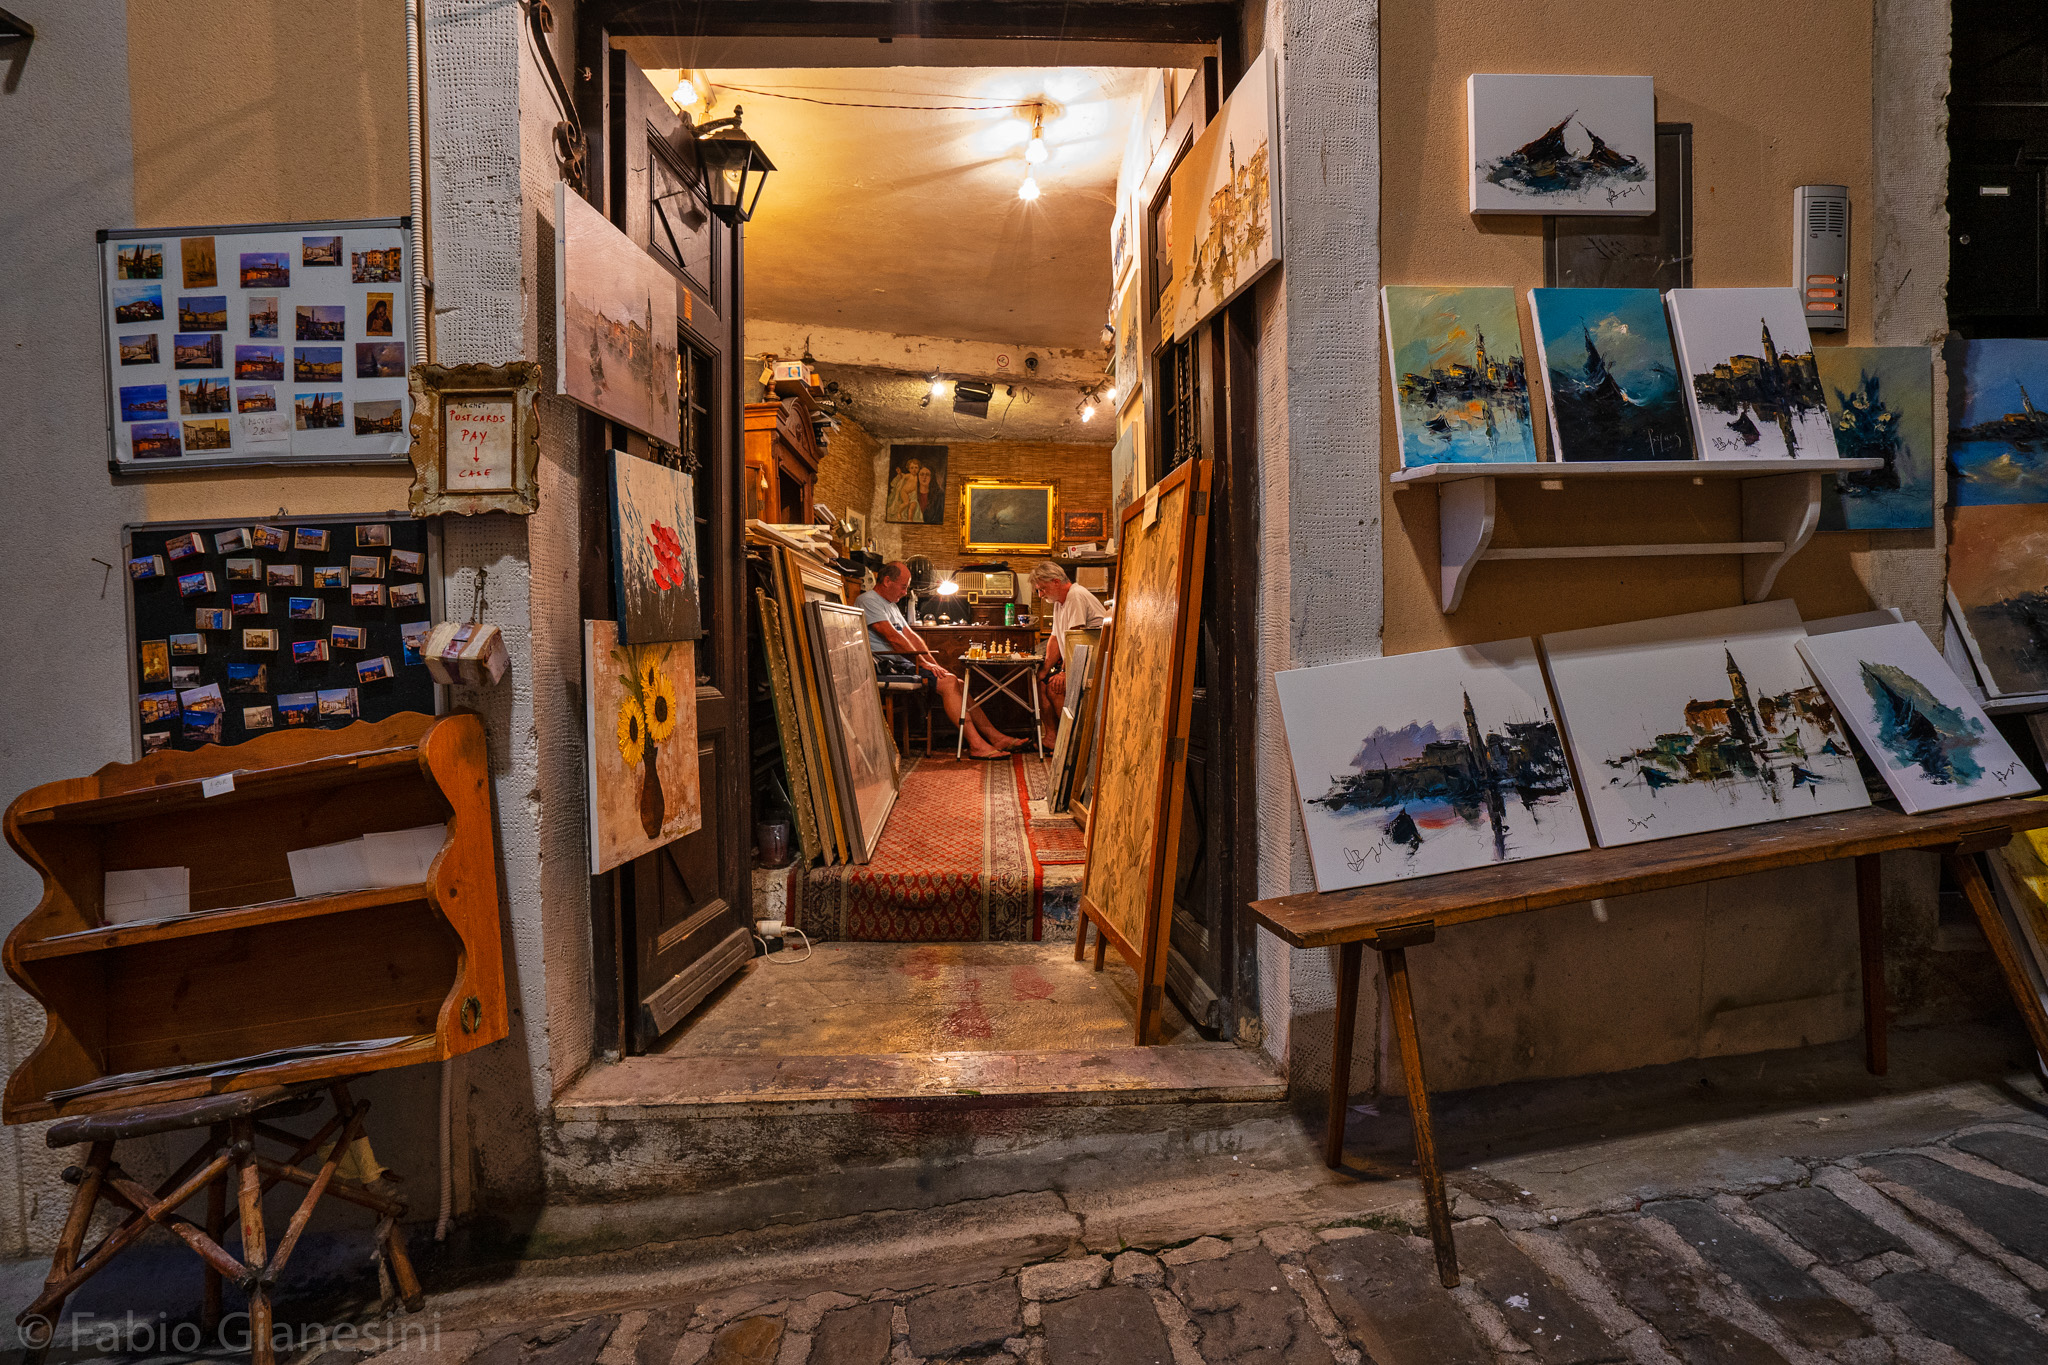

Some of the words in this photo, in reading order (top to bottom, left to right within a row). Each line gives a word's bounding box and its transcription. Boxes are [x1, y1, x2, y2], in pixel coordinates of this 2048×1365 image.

[450, 410, 506, 422] POSTCARDS
[461, 429, 487, 445] PAY
[459, 469, 492, 477] CASE
